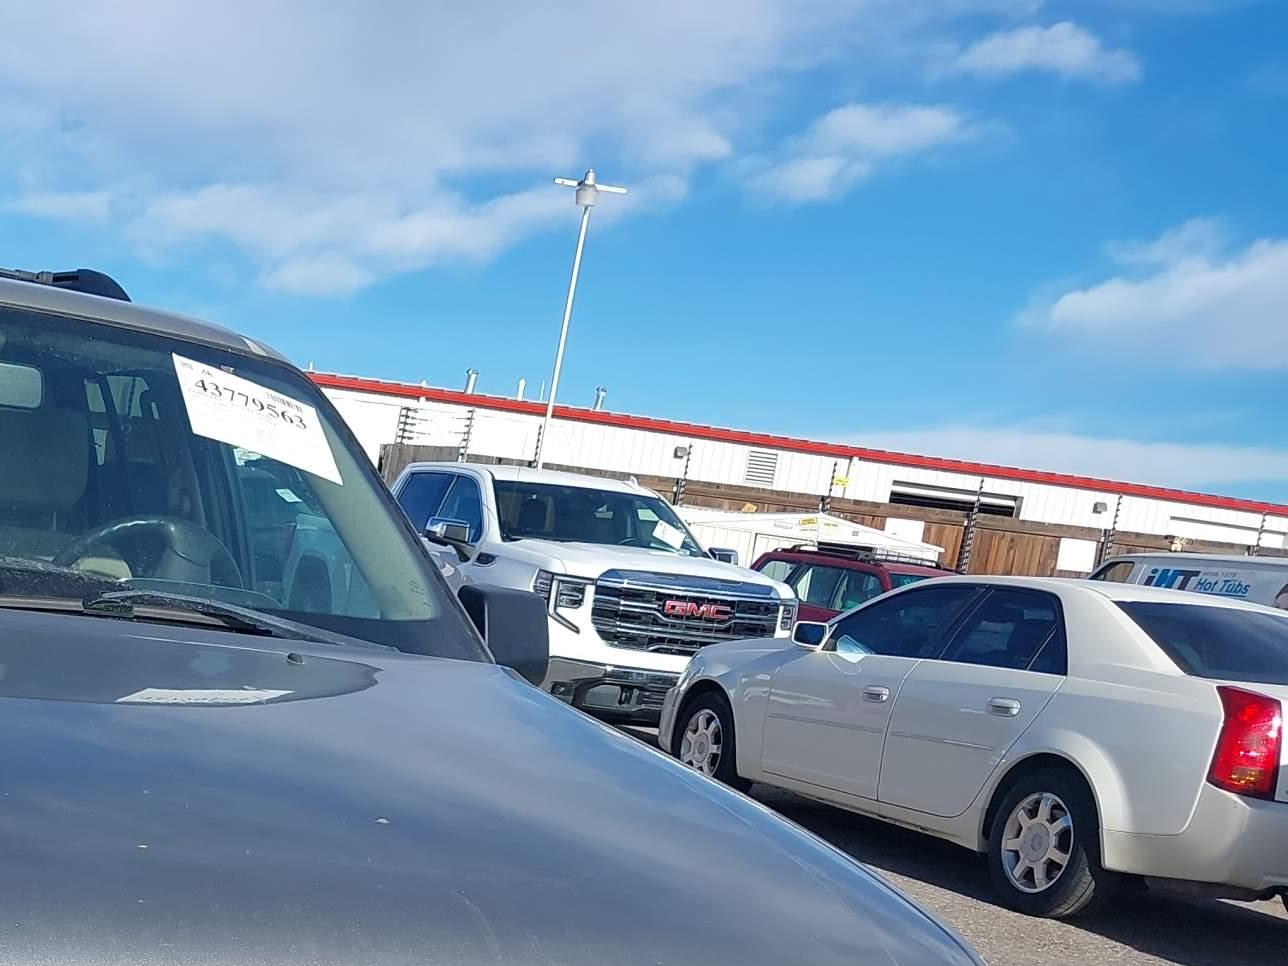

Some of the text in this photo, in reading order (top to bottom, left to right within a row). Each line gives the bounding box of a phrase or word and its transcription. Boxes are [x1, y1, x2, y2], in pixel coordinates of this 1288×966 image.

[195, 379, 307, 430] 43779563
[1193, 578, 1216, 591] Hot
[1220, 579, 1251, 595] Tubs
[664, 600, 731, 620] GMC
